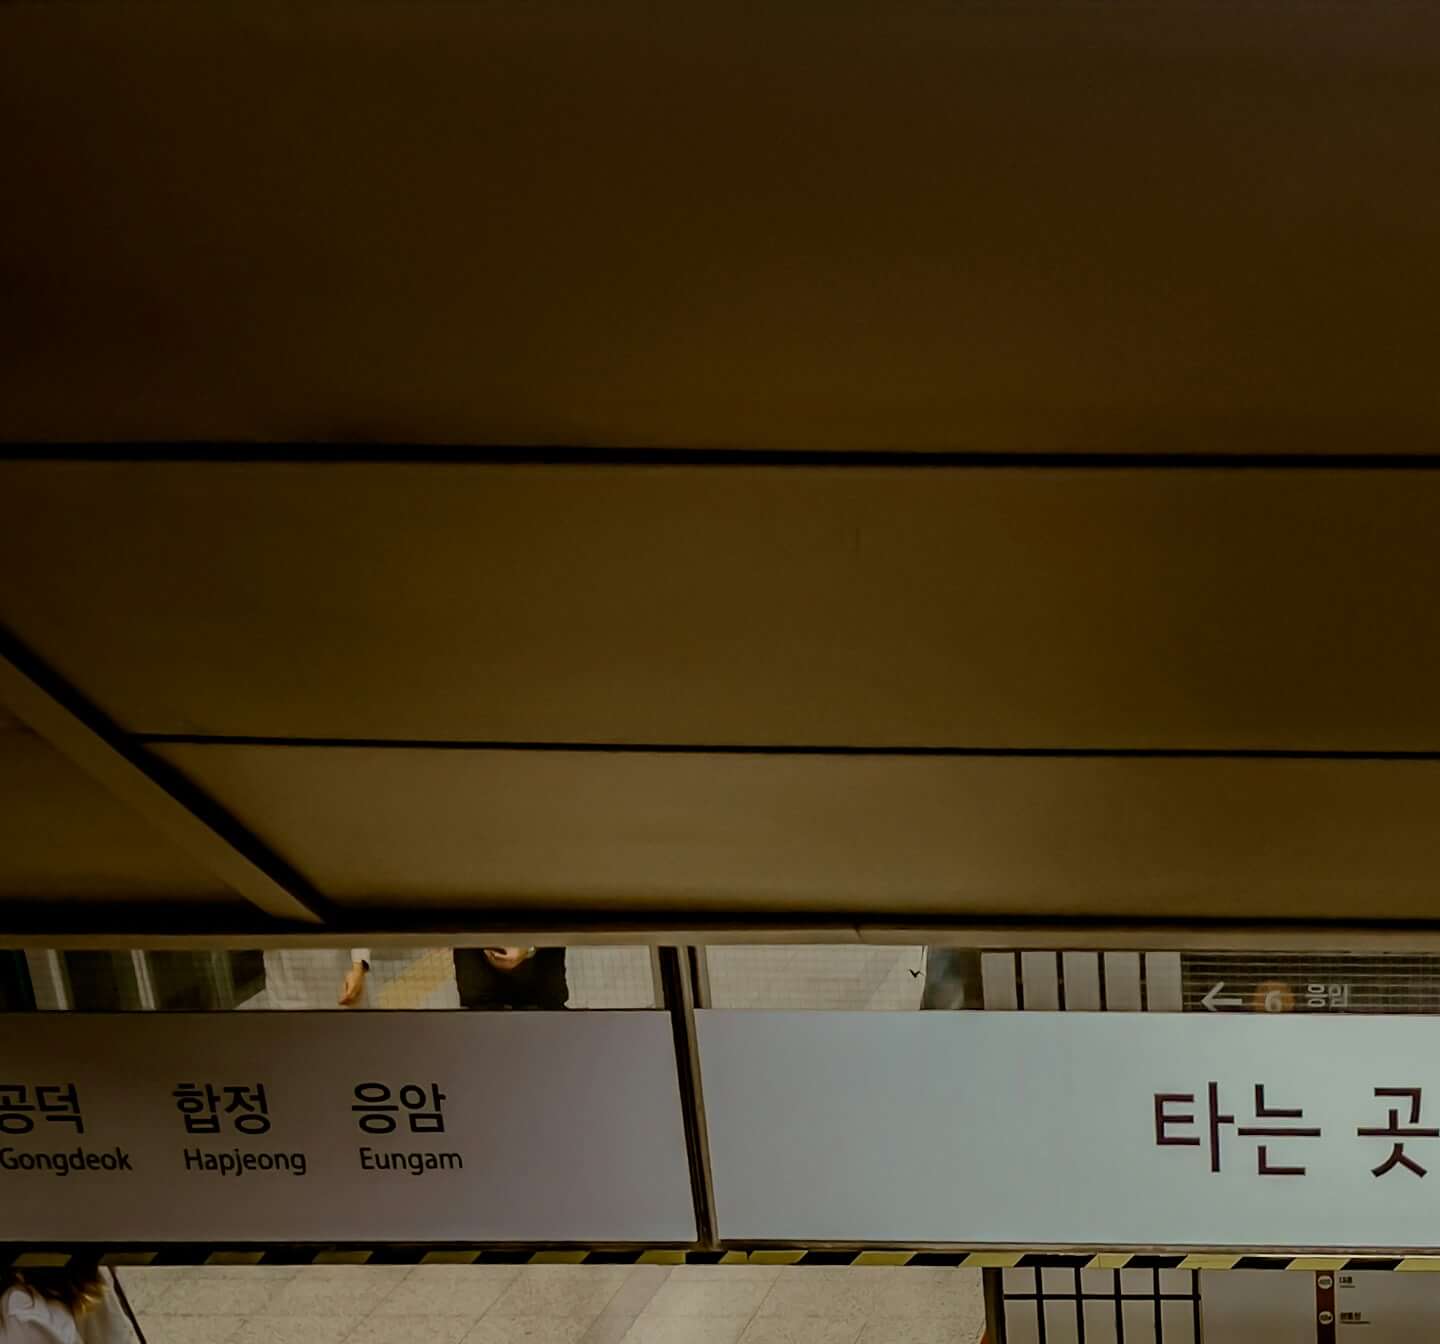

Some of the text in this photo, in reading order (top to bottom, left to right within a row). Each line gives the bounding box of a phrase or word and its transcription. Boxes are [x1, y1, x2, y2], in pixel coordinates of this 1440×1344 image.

[173, 1082, 272, 1135] 합정
[351, 1082, 447, 1134] 응암
[1153, 1081, 1440, 1178] 타는 곳
[0, 1147, 463, 1176] Gongdeok Hapjeong Eungam
